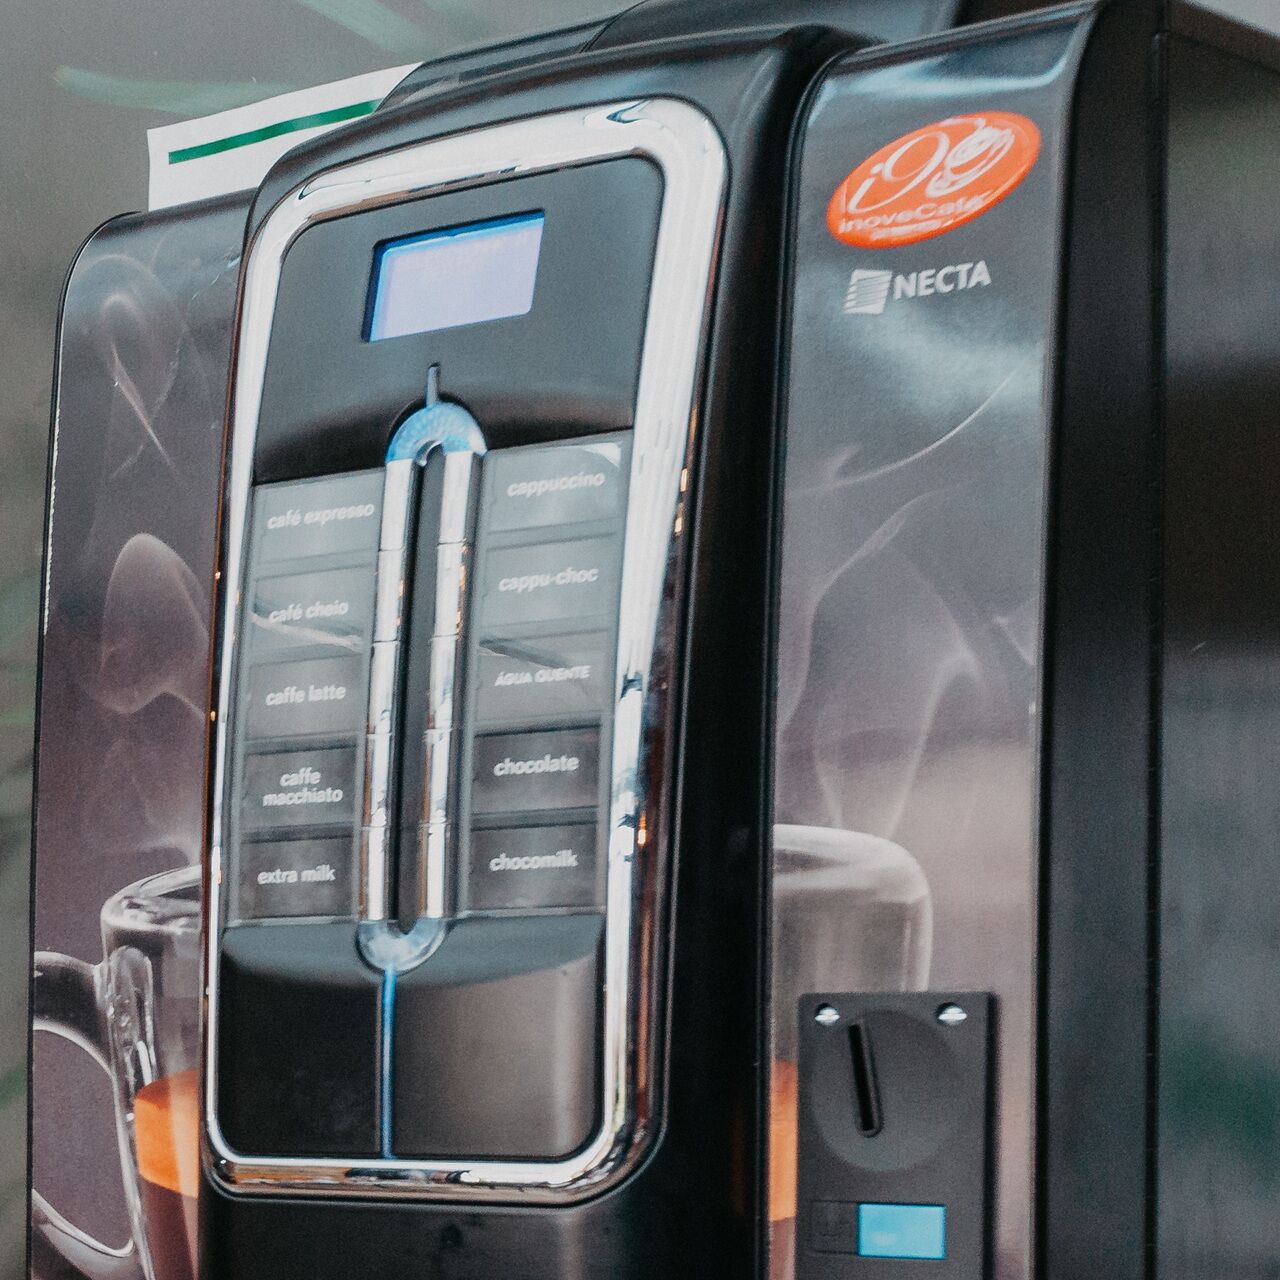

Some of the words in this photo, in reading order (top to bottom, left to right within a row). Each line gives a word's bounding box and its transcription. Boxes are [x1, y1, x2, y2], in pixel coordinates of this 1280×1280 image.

[893, 260, 992, 300] NECTA
[507, 472, 605, 497] cappuccino
[267, 509, 301, 530] café
[304, 503, 375, 526] expresso
[499, 567, 599, 592] cappu-choc
[269, 603, 303, 622] café
[305, 600, 349, 619] cheio
[266, 686, 305, 706] caffe
[308, 685, 346, 702] latte
[494, 754, 579, 776] chocolate
[280, 767, 322, 787] caffe
[262, 787, 344, 807] macchiato
[490, 849, 579, 872] chocomilk
[257, 868, 298, 885] extra
[301, 864, 336, 883] milk
